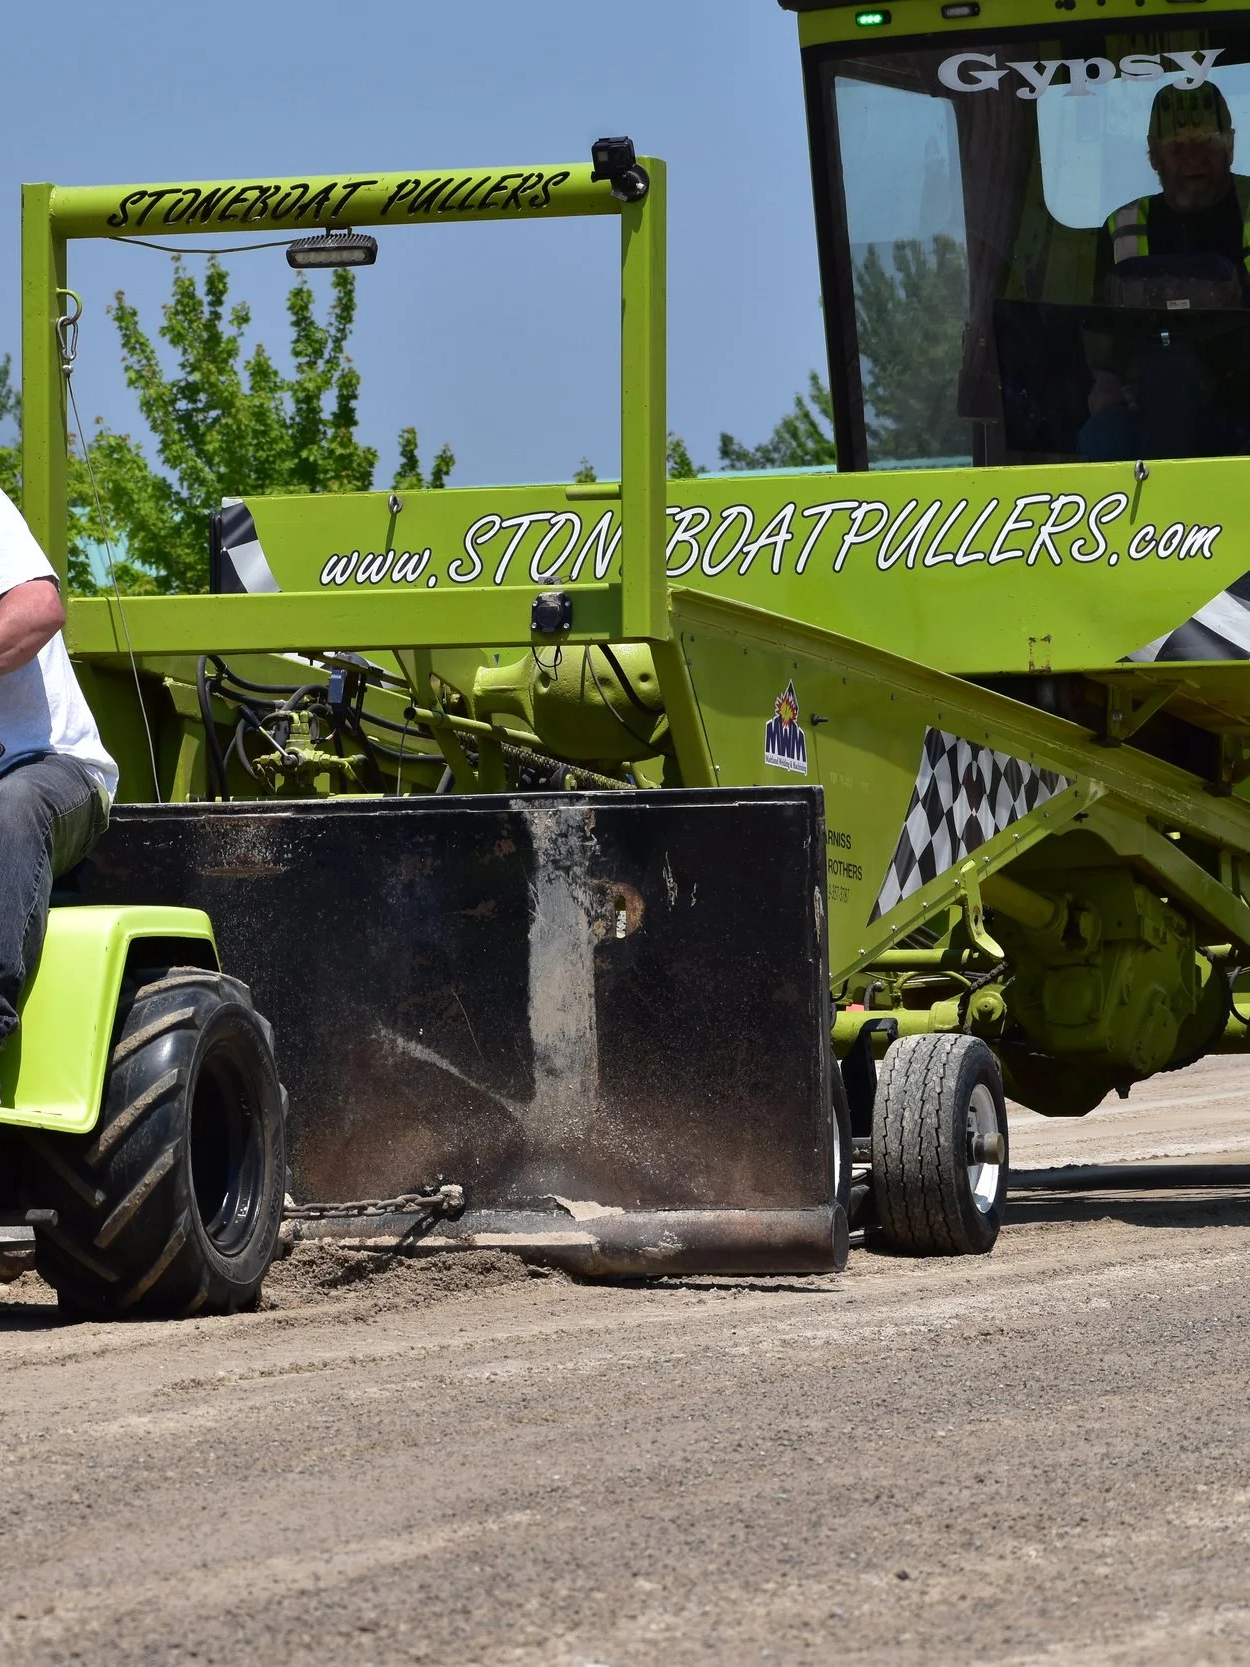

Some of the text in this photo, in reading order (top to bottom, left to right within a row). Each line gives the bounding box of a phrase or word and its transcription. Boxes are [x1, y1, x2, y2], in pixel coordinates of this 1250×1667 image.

[937, 48, 1225, 100] Gypsy
[107, 171, 570, 228] STONEBOAT PULLERS
[319, 490, 1222, 588] www.STONBOATPULLERS.com
[826, 829, 852, 850] RNISS
[828, 859, 863, 881] ROTHERS
